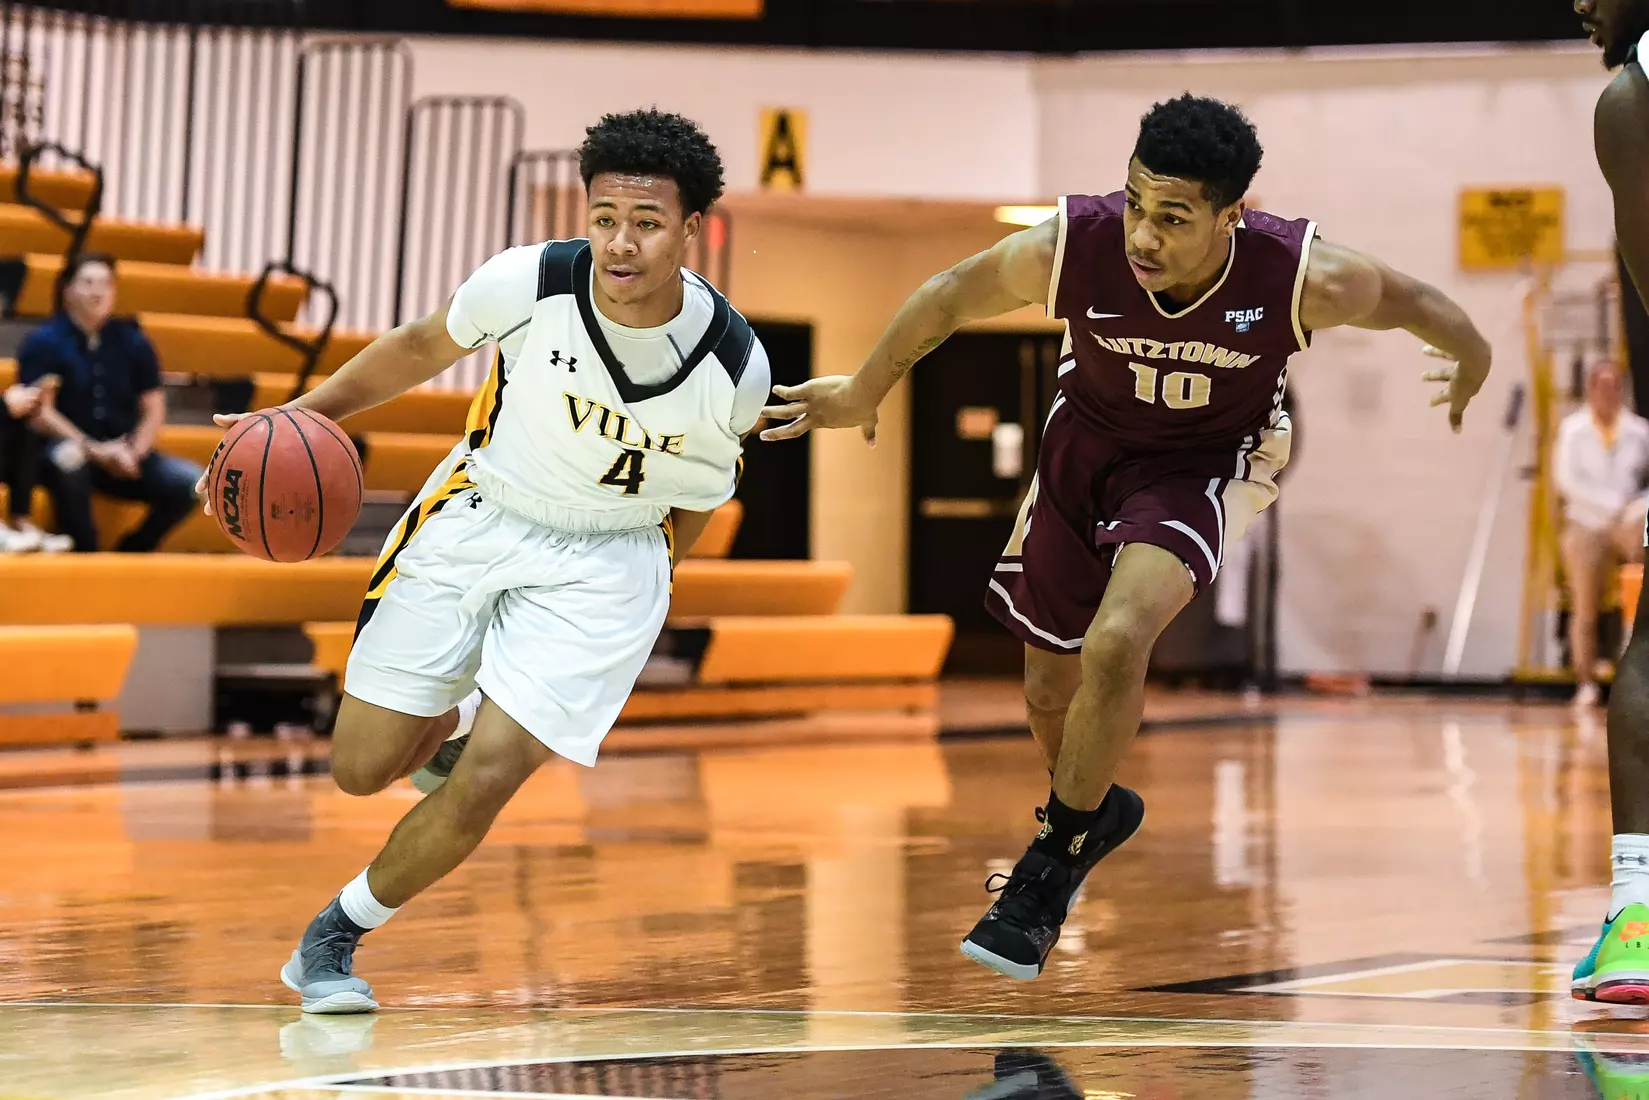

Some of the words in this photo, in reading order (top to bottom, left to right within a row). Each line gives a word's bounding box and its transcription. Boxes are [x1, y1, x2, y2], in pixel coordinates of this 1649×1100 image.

[761, 110, 802, 186] A
[1225, 306, 1264, 322] PSAC
[1128, 362, 1211, 409] 10
[598, 448, 645, 495] 4
[223, 469, 245, 540] NCAA
[1625, 941, 1649, 949] LB
